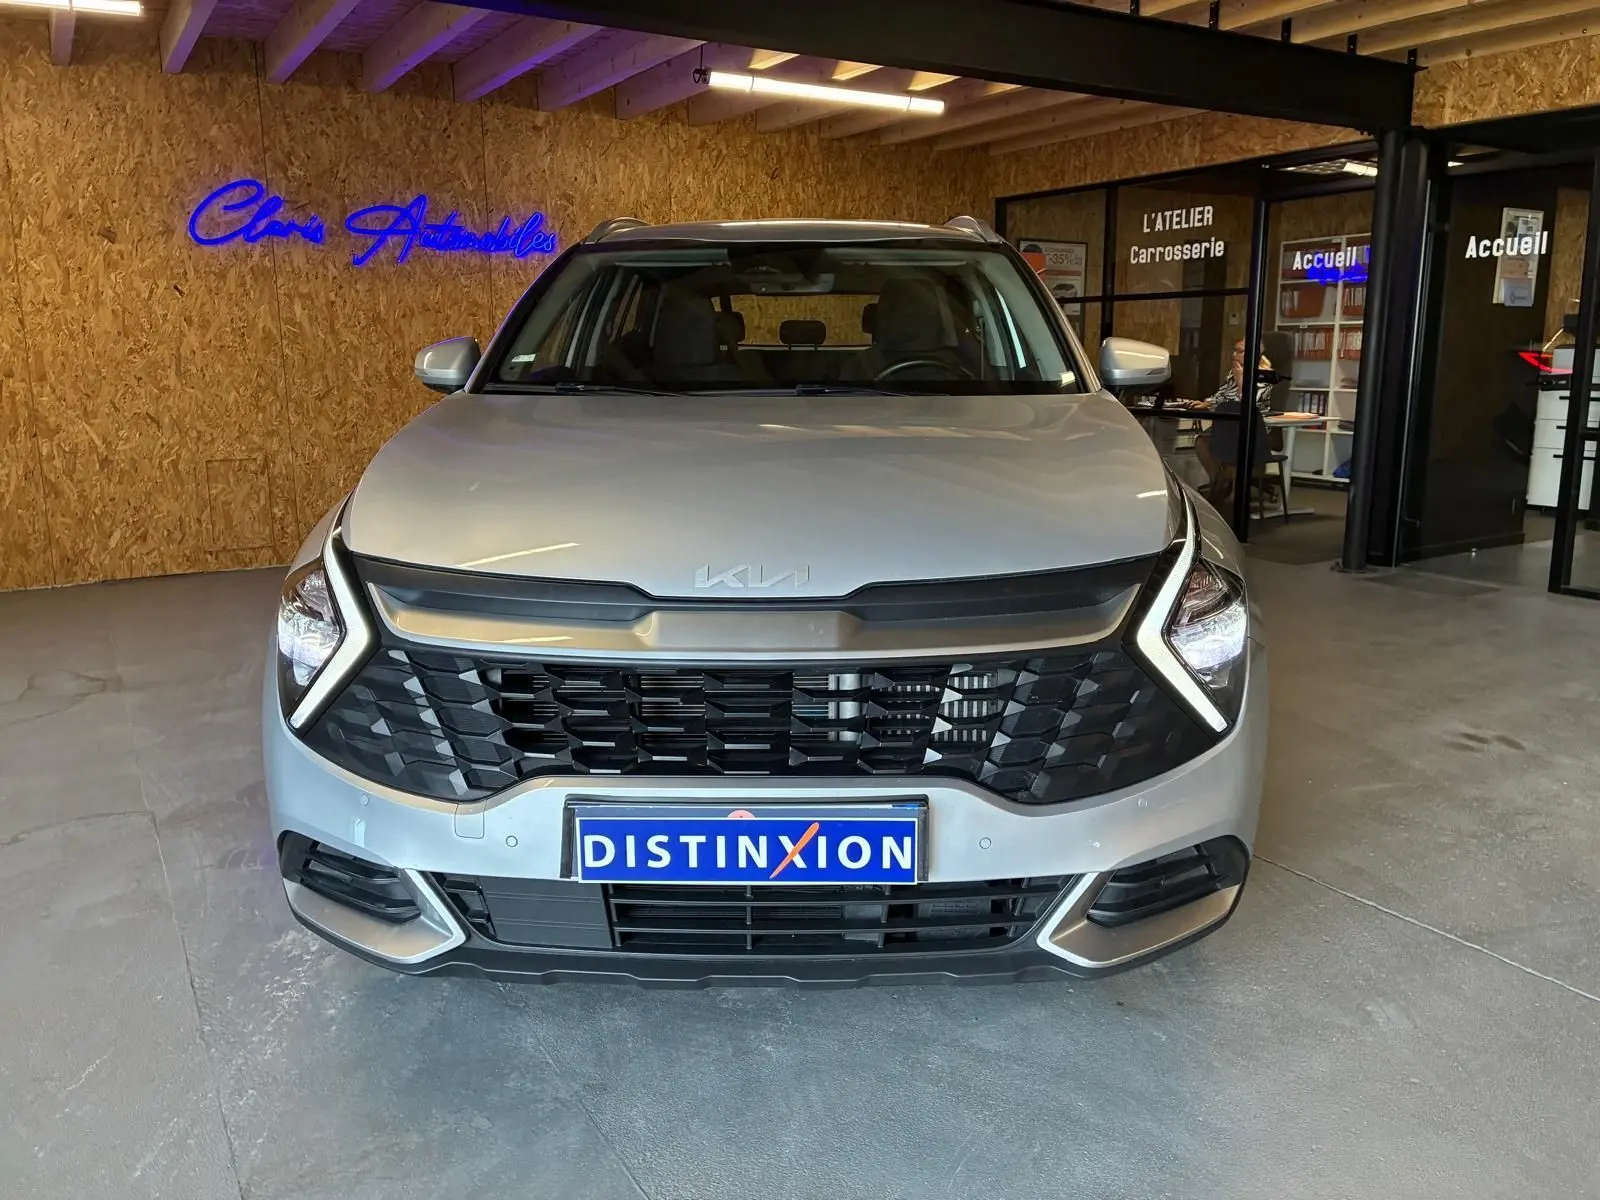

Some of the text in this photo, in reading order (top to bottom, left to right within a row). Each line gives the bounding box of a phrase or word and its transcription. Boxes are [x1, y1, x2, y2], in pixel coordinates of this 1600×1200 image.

[345, 194, 555, 267] Automobiles
[1142, 205, 1213, 233] L'ATELIER
[1130, 237, 1225, 264] Carrosserie
[1292, 246, 1357, 270] Accueil
[1465, 231, 1548, 259] Accueil
[694, 564, 810, 588] KIA
[584, 822, 912, 878] DISTINXION
